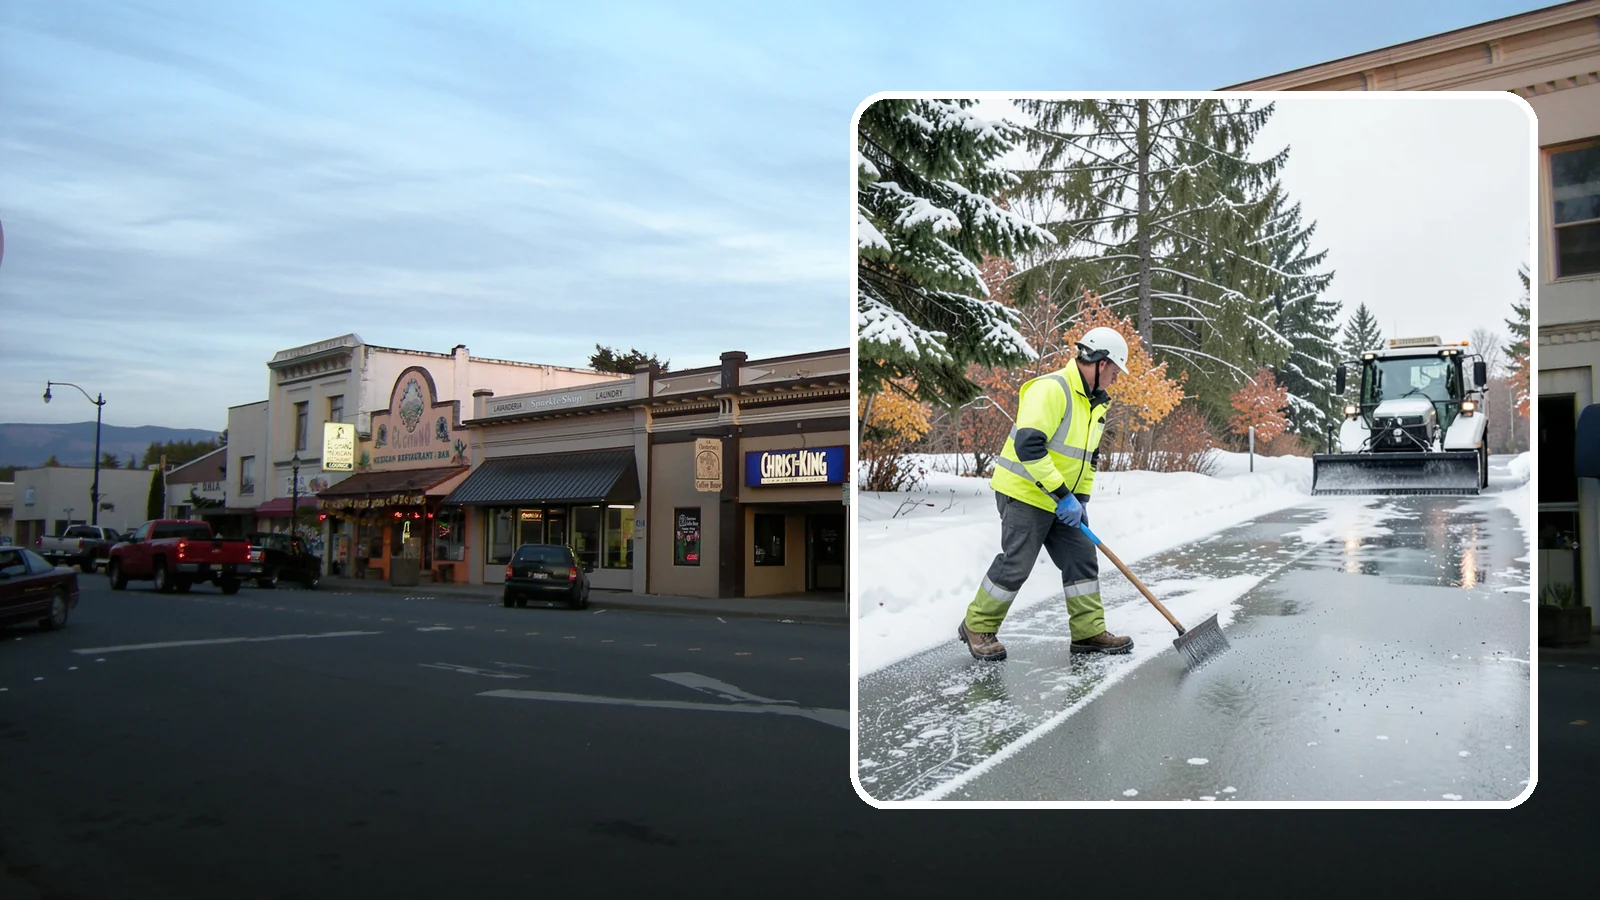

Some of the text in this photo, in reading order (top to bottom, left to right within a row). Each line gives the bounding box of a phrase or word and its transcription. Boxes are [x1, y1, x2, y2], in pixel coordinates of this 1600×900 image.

[530, 396, 561, 408] Sparkle
[562, 395, 582, 404] Shop
[595, 388, 623, 400] LAUNDRY
[397, 451, 433, 462] RESTAURANT
[438, 450, 450, 459] BAR
[761, 450, 827, 478] CHRIST KING
[696, 481, 709, 489] Coffee
